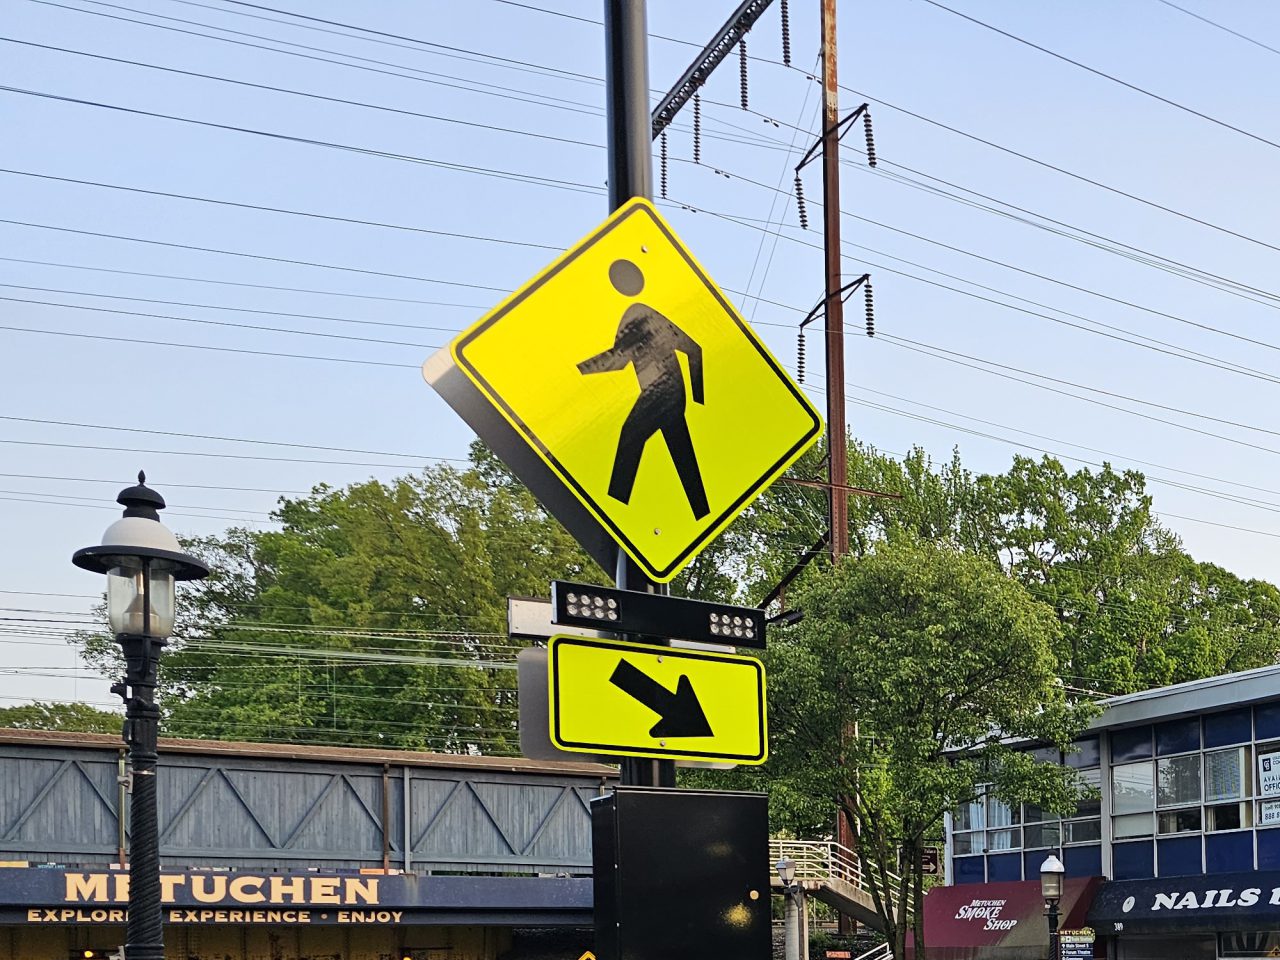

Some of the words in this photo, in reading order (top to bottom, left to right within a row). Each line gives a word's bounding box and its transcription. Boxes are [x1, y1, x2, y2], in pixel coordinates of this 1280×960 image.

[1151, 887, 1262, 911] NAILS
[28, 909, 129, 922] EXPLOR
[170, 910, 310, 923] EXPERIENCE
[337, 911, 402, 923] ENJOY
[955, 905, 1002, 921] SMOKE
[983, 918, 1018, 931] SHOP
